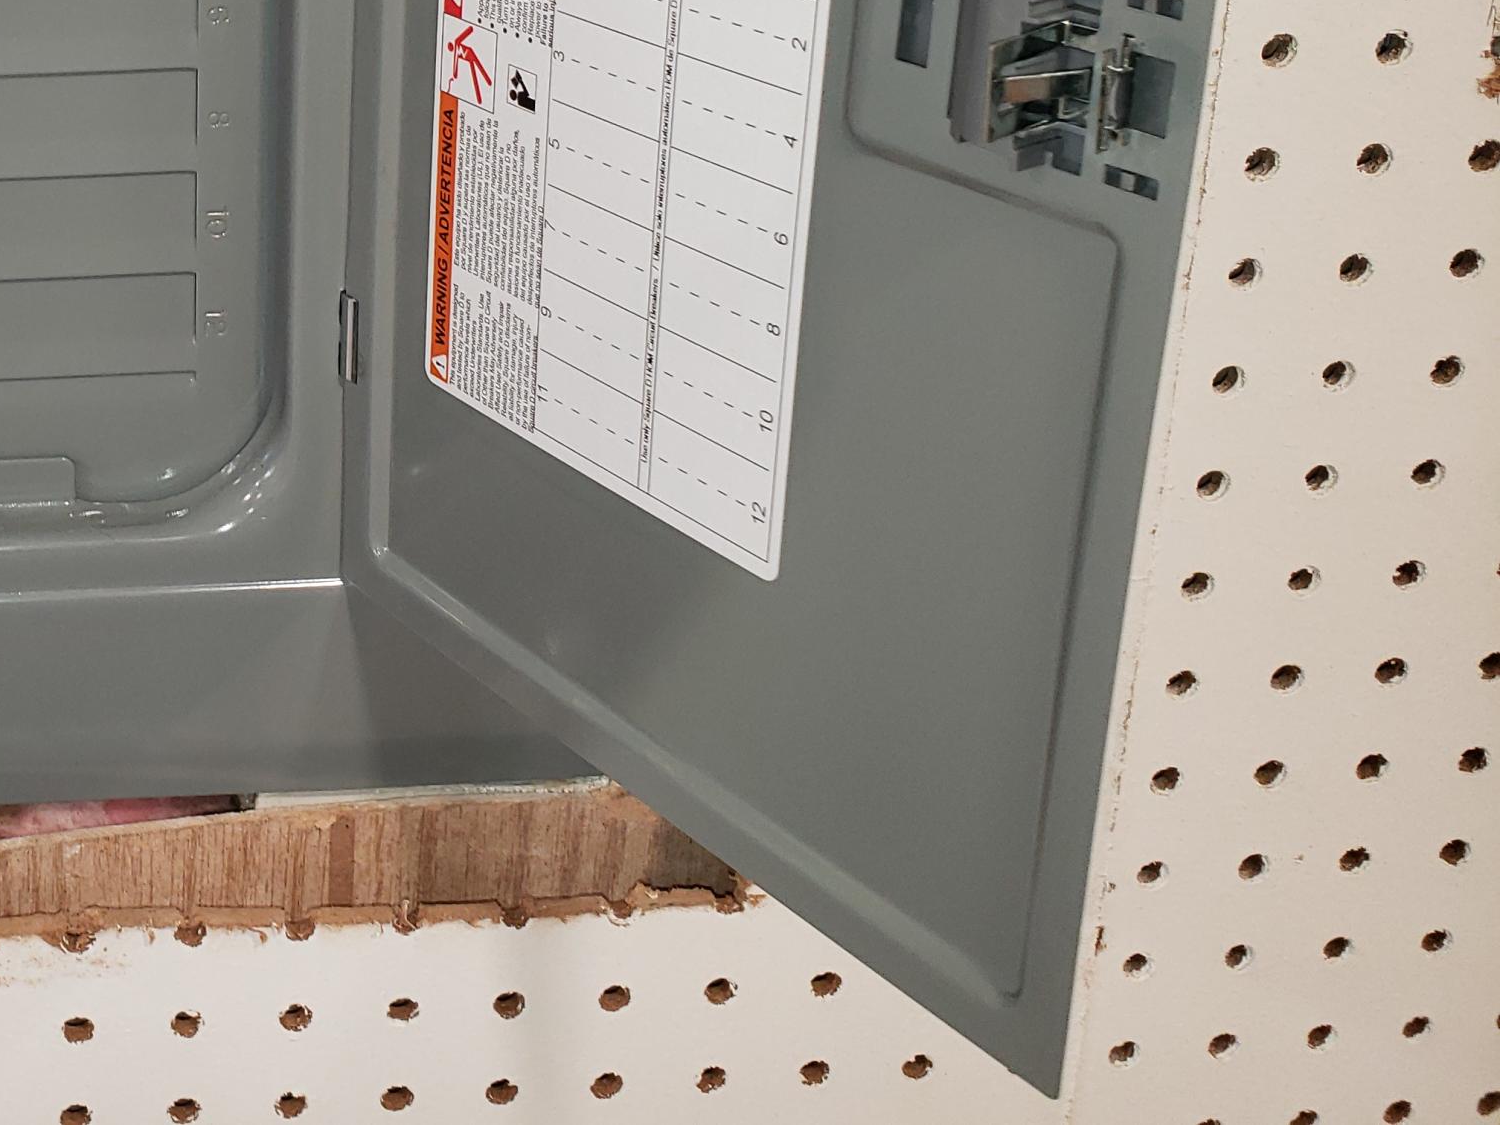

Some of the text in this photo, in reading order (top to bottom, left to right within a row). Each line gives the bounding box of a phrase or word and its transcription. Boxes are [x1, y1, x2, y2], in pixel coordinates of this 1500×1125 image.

[542, 2, 550, 12] to
[539, 14, 549, 46] Failure
[791, 37, 807, 52] 2
[553, 50, 565, 62] 3
[548, 137, 560, 150] 5
[783, 134, 798, 148] 4
[438, 110, 453, 245] ADVERTENCIA
[543, 218, 556, 231] 7
[773, 232, 788, 246] 6
[435, 256, 448, 346] WARNING
[540, 305, 552, 318] 9
[766, 322, 781, 336] 8
[536, 384, 548, 402] 11
[759, 409, 774, 432] 10
[751, 501, 766, 523] 12
